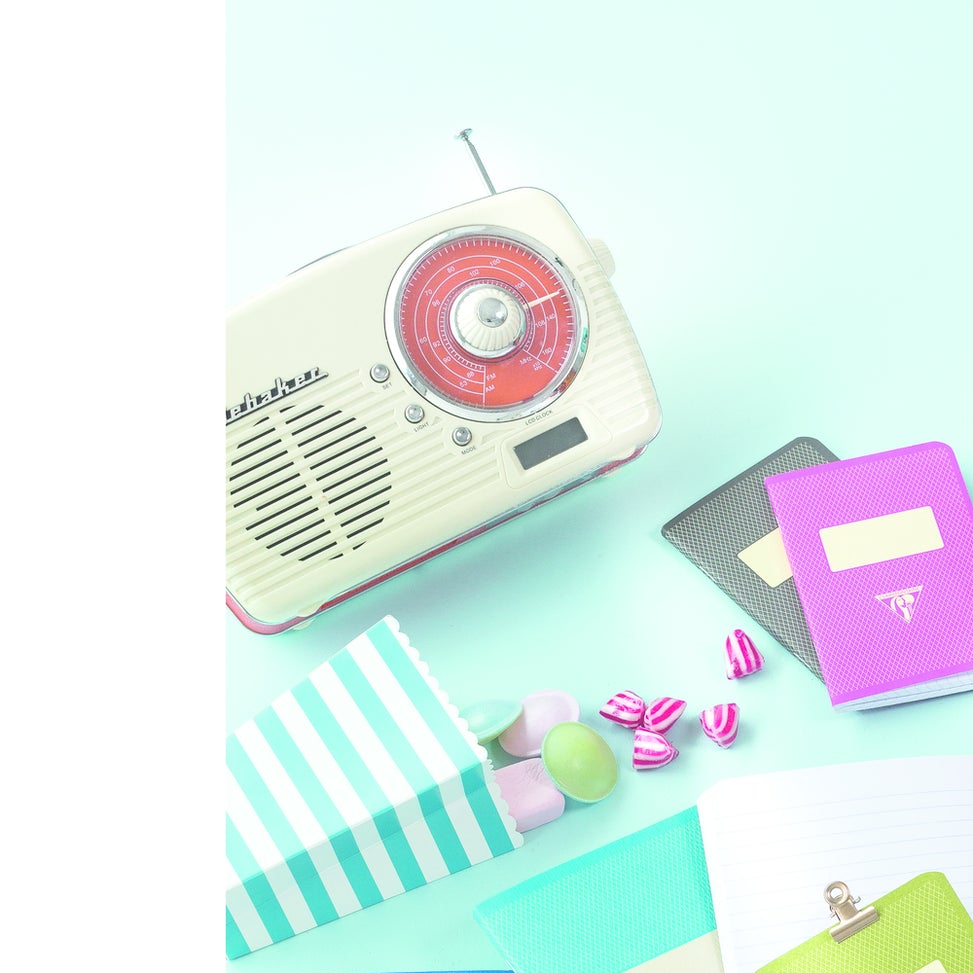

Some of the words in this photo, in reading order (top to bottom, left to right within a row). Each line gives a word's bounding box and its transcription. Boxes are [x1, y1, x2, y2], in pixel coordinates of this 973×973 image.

[489, 258, 501, 267] 100
[486, 373, 497, 382] FM
[382, 382, 392, 390] SET
[485, 384, 495, 393] AM
[525, 417, 536, 426] LCD
[536, 410, 553, 421] CLOCK
[414, 421, 429, 433] LIGHT
[461, 445, 477, 456] MODE
